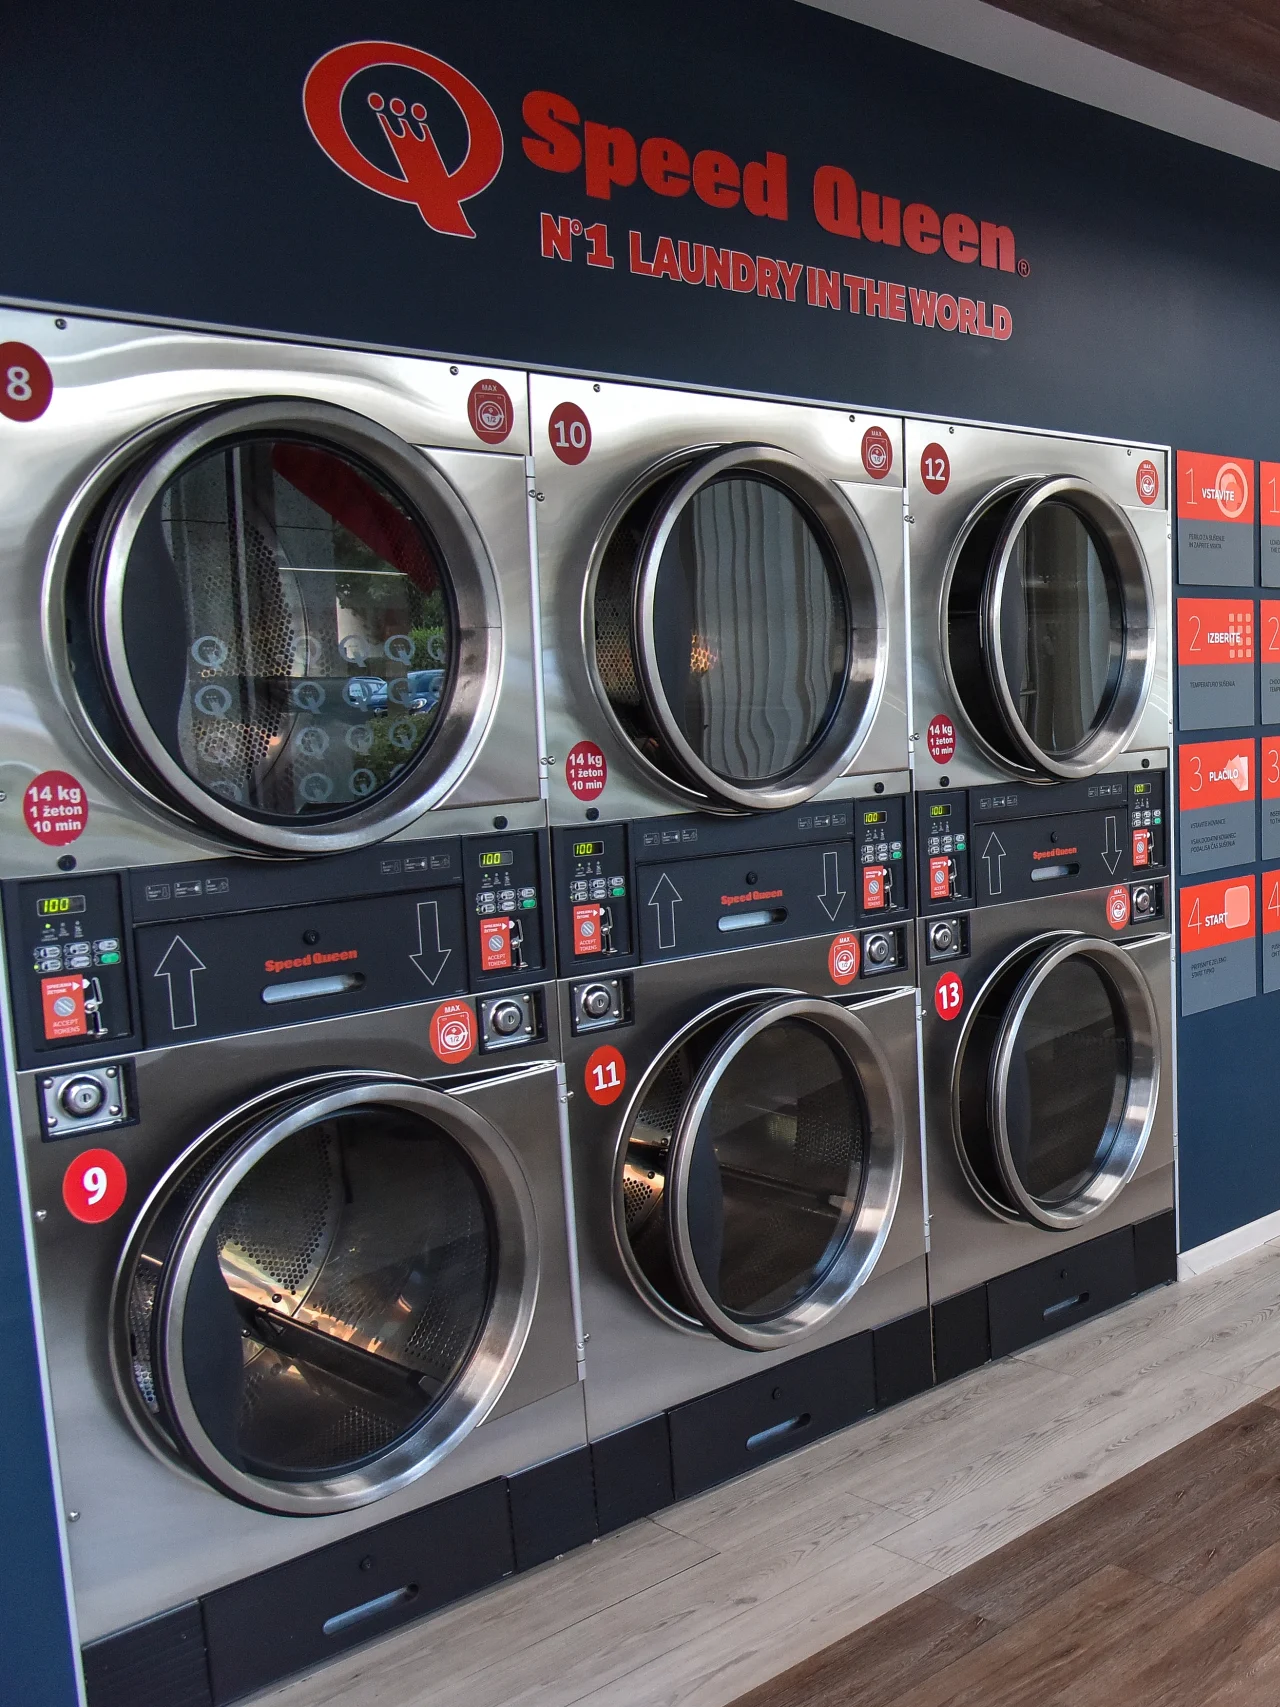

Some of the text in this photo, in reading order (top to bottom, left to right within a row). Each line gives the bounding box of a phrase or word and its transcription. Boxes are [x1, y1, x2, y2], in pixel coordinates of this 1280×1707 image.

[522, 91, 788, 221] Speed
[630, 230, 803, 302] LAUNDRY
[806, 266, 841, 310] IN
[844, 274, 907, 323] THE
[908, 288, 1014, 341] WORLD
[6, 366, 32, 401] 8
[482, 384, 497, 392] MAX
[554, 420, 586, 449] 10
[925, 456, 946, 481] 12
[1185, 468, 1235, 504] 1 VSTAVITE
[1268, 477, 1280, 513] 1
[1189, 616, 1241, 651] 2 IZBERITE
[1268, 616, 1280, 650] 2
[929, 724, 953, 737] 14 kg
[936, 736, 953, 746] žeton
[932, 746, 953, 755] 10 min
[569, 753, 603, 768] 14 kg
[1268, 750, 1280, 783] 3
[570, 766, 604, 778] 1 žeton
[1189, 756, 1238, 791] 3 PLAČILO
[28, 785, 81, 803] 14 kg
[572, 780, 602, 790] 10 min
[30, 802, 82, 818] 1 žeton
[866, 813, 878, 822] 100
[932, 806, 942, 816] 100
[33, 819, 82, 832] 10 min
[482, 853, 500, 864] 100
[576, 844, 592, 855] 100
[1033, 846, 1077, 860] Speed Queen
[44, 898, 69, 912] 100
[720, 888, 782, 906] Speed Queen
[1267, 881, 1280, 916] 4
[1187, 897, 1228, 934] 4 START
[265, 948, 358, 973] Speed Queen
[938, 982, 960, 1010] 13
[444, 1004, 460, 1013] MAX
[53, 1018, 79, 1028] ACCEPT
[54, 1026, 80, 1035] TOKENS
[592, 1060, 619, 1092] 11
[83, 1166, 107, 1206] 9
